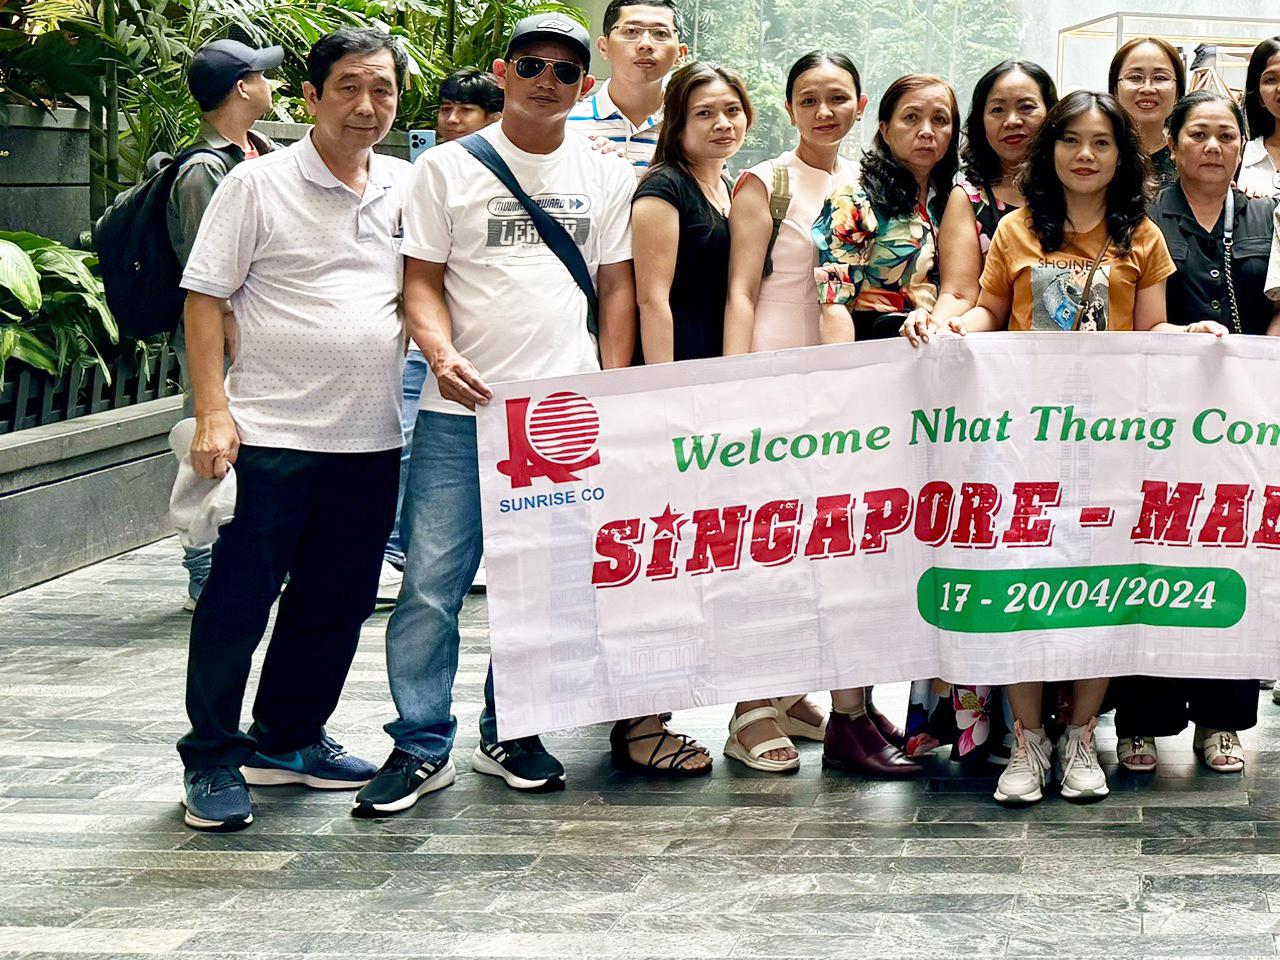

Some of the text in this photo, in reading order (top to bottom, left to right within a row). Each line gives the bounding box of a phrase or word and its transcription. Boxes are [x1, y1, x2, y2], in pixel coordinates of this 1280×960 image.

[672, 425, 890, 472] Welcome
[909, 406, 1012, 445] Nhat
[1030, 406, 1177, 449] Thang
[500, 487, 605, 512] SUNRISE CO
[940, 581, 971, 612] 17
[1004, 577, 1216, 615] 20/04/2024
